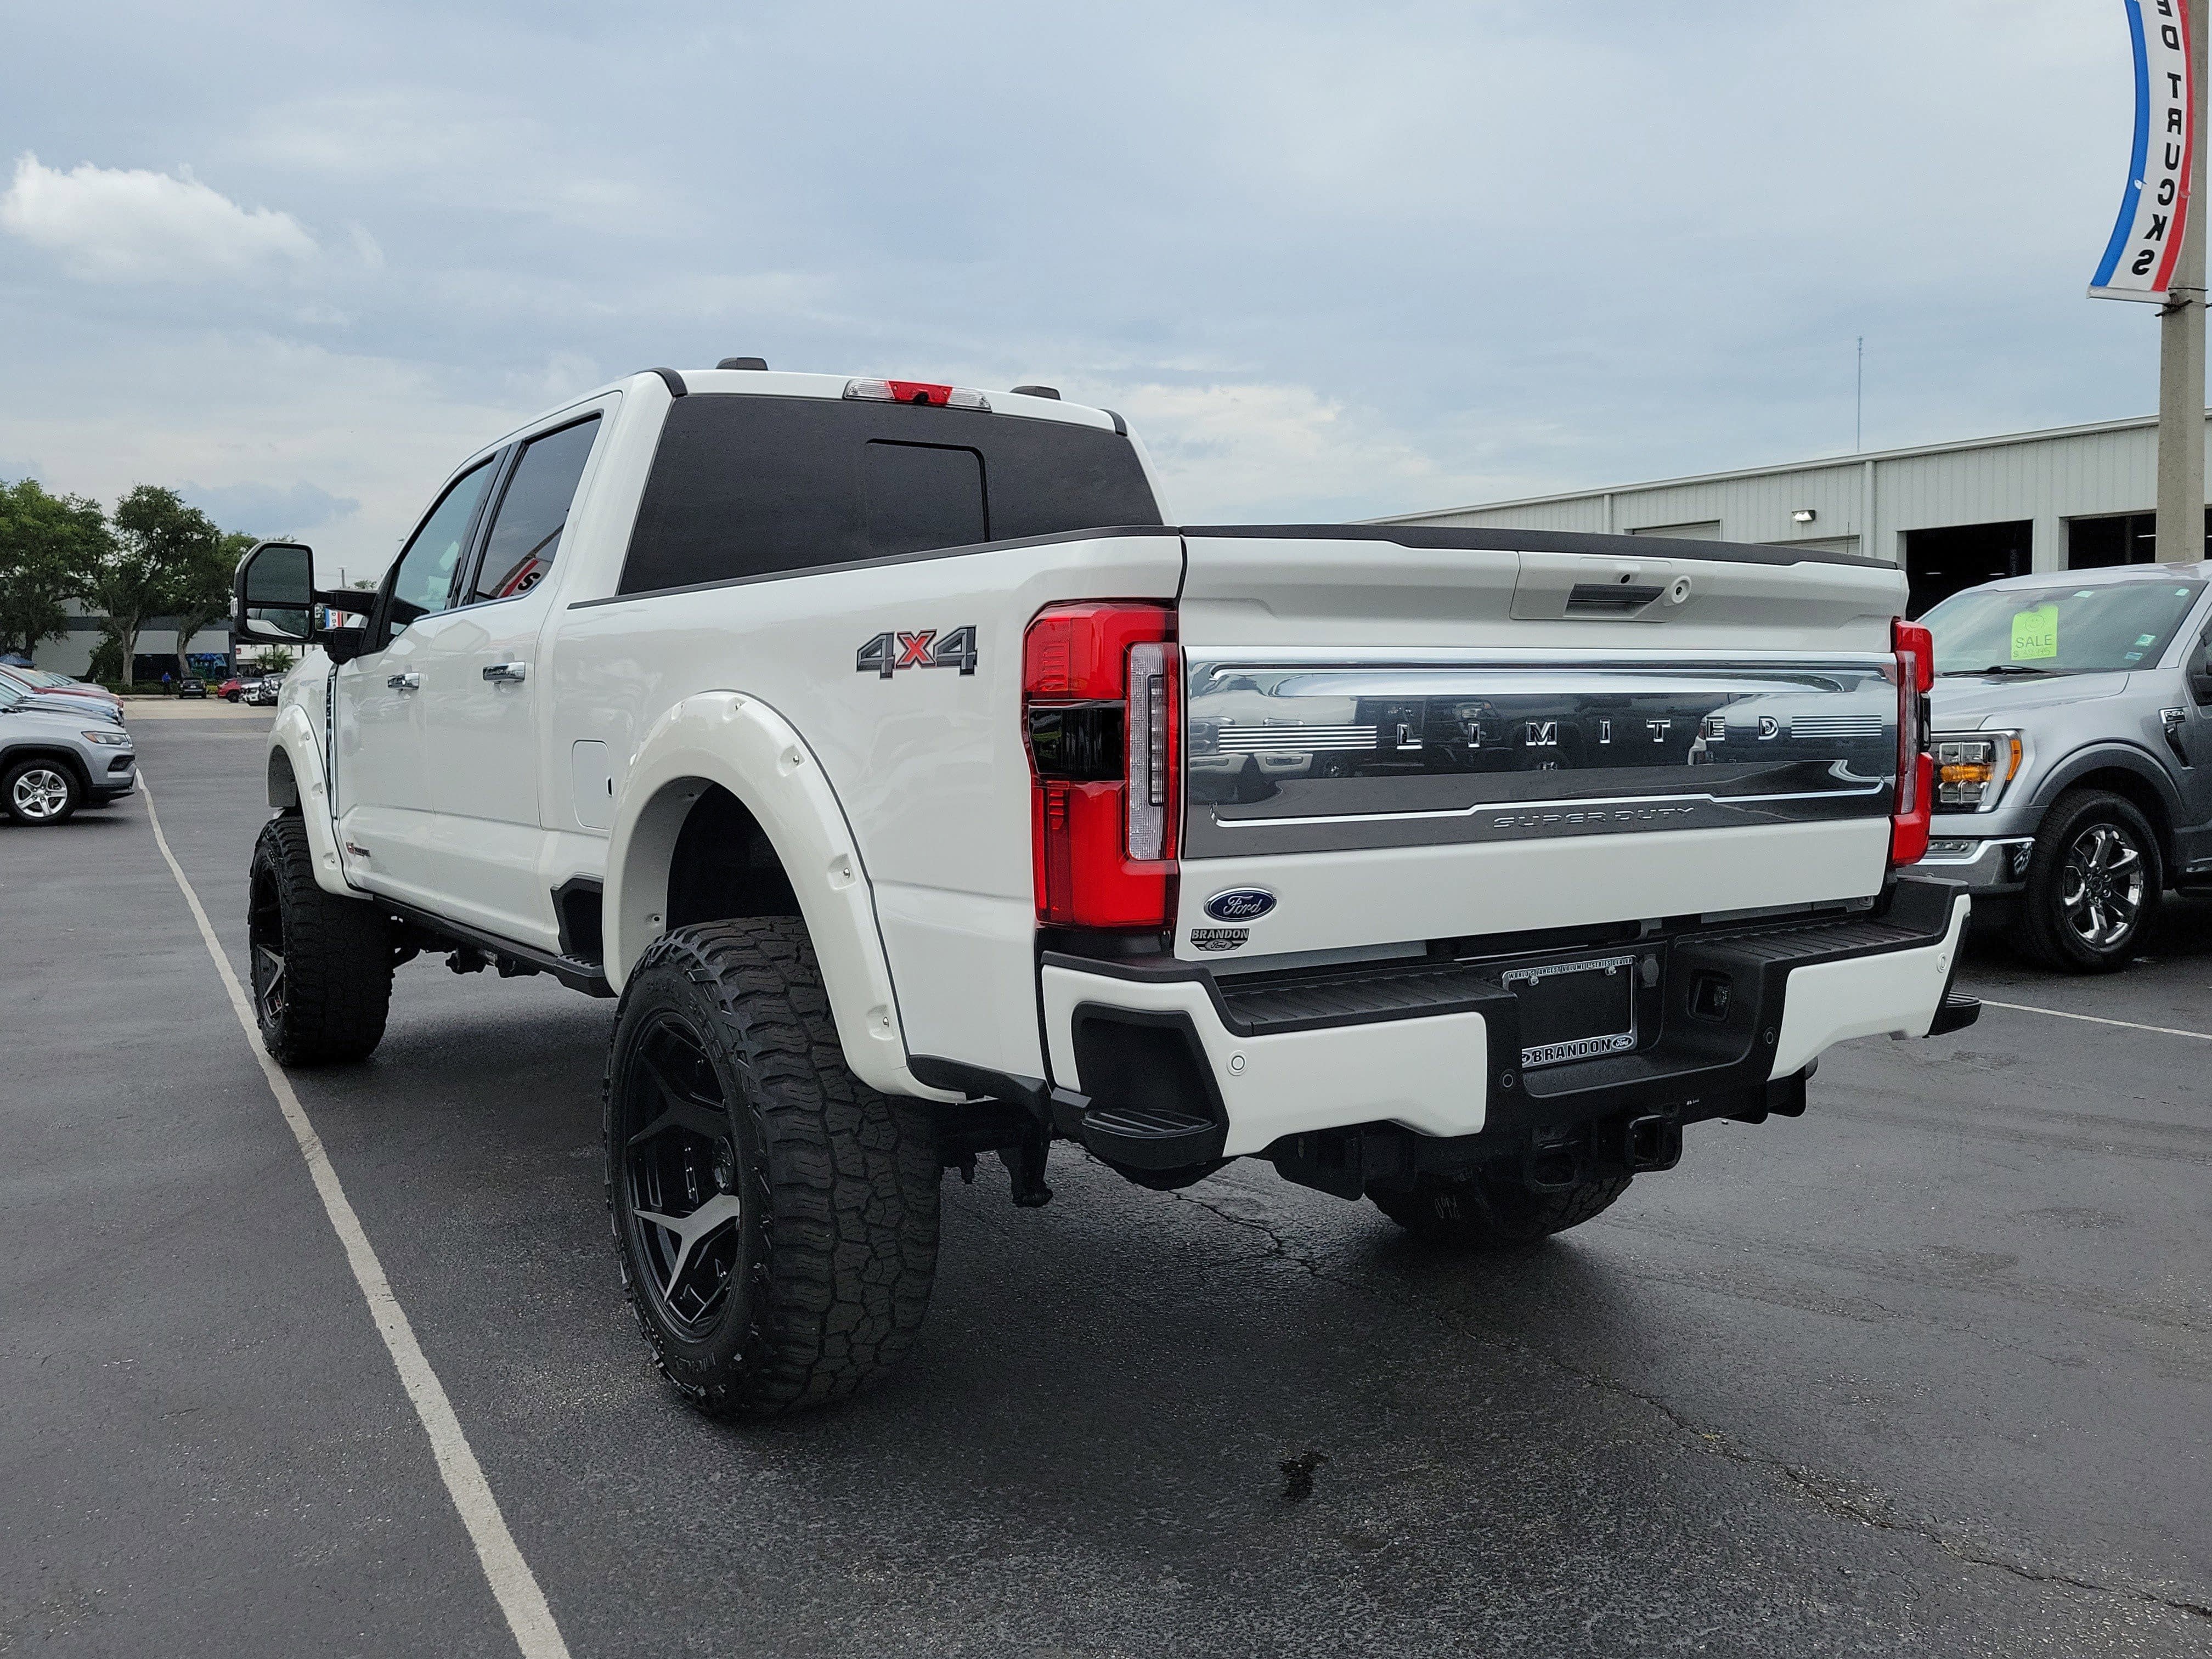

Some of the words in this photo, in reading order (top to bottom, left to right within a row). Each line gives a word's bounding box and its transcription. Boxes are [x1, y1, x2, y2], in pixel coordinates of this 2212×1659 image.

[2016, 634, 2053, 648] SALE
[856, 624, 978, 680] 4X4
[1396, 716, 1780, 750] LIMITED
[1493, 811, 1607, 828] SUPER
[1615, 806, 1695, 822] DUTY
[1223, 895, 1263, 915] Ford
[1191, 929, 1249, 939] BRANDON
[1210, 941, 1227, 949] Ford
[1532, 1039, 1611, 1063] BRANDON
